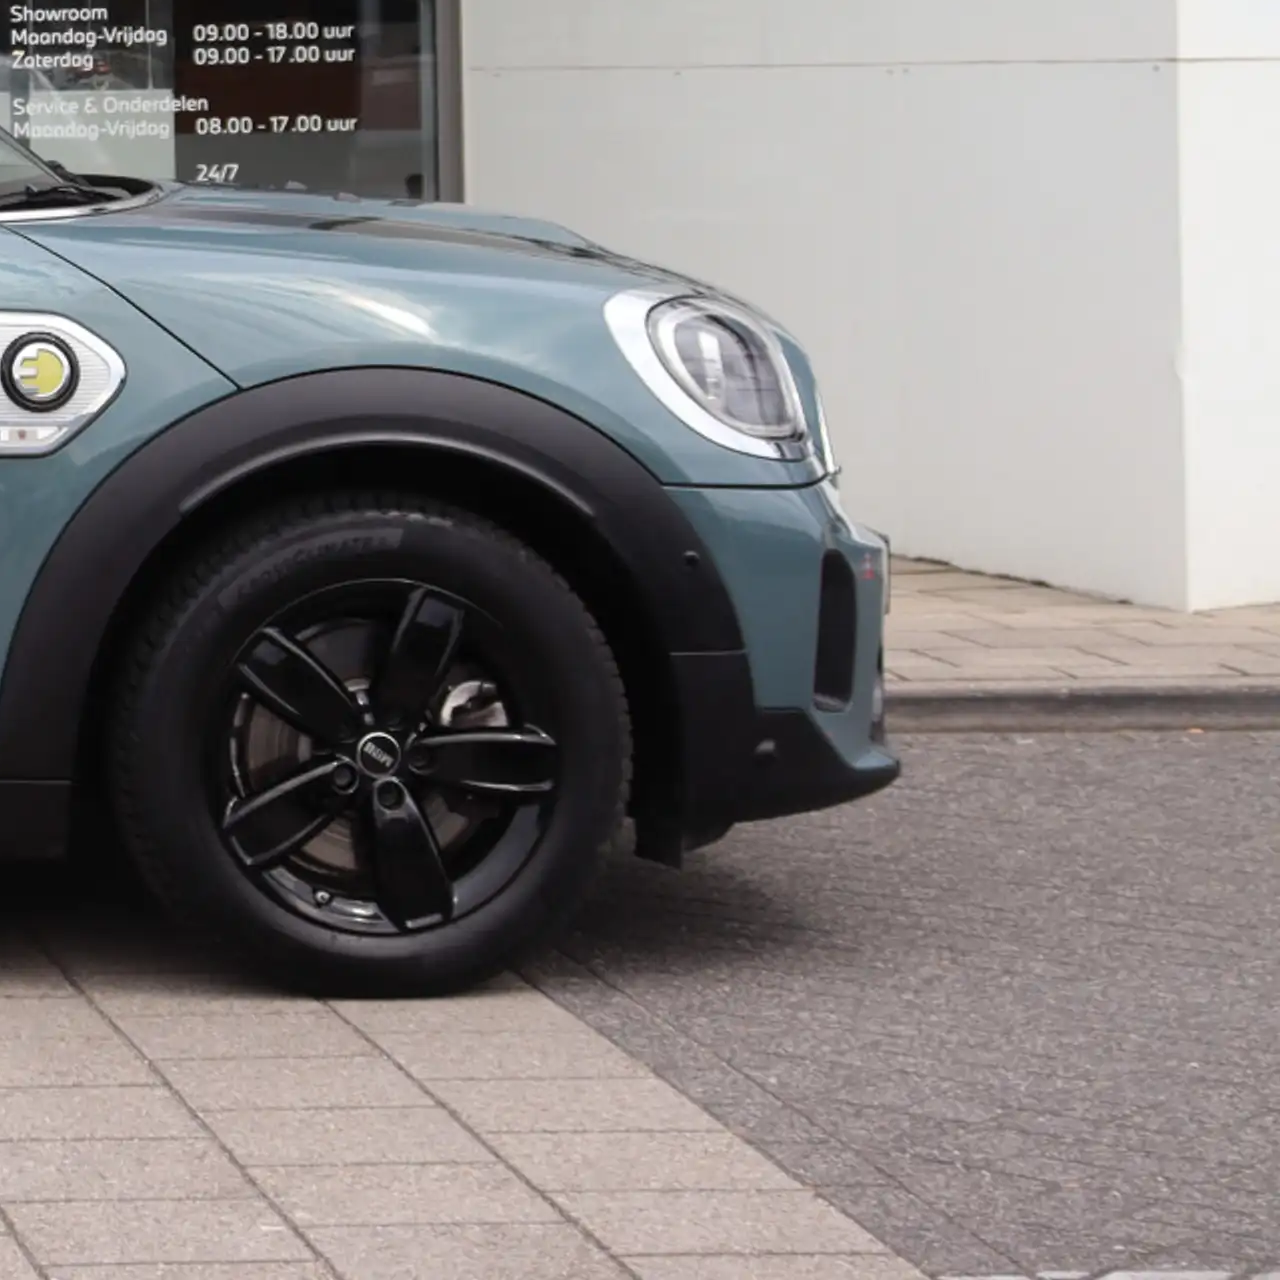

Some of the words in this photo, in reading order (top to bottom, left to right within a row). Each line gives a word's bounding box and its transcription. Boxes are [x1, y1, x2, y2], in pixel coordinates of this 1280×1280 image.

[10, 5, 108, 23] Showroom
[11, 26, 167, 48] Maandag-Vrijdag
[193, 23, 250, 42] 09.00
[265, 22, 319, 40] 18.00
[322, 25, 355, 39] uur
[11, 50, 94, 71] Zaterdag
[193, 47, 250, 65] 09.00
[323, 48, 356, 62] uur
[13, 98, 79, 116] Service
[84, 98, 98, 114] &
[104, 95, 209, 114] Onderdelen
[13, 120, 170, 140] Maandag-Vrijdag
[195, 116, 253, 135] 08.00
[326, 117, 358, 131] uur
[196, 164, 240, 182] 24/7
